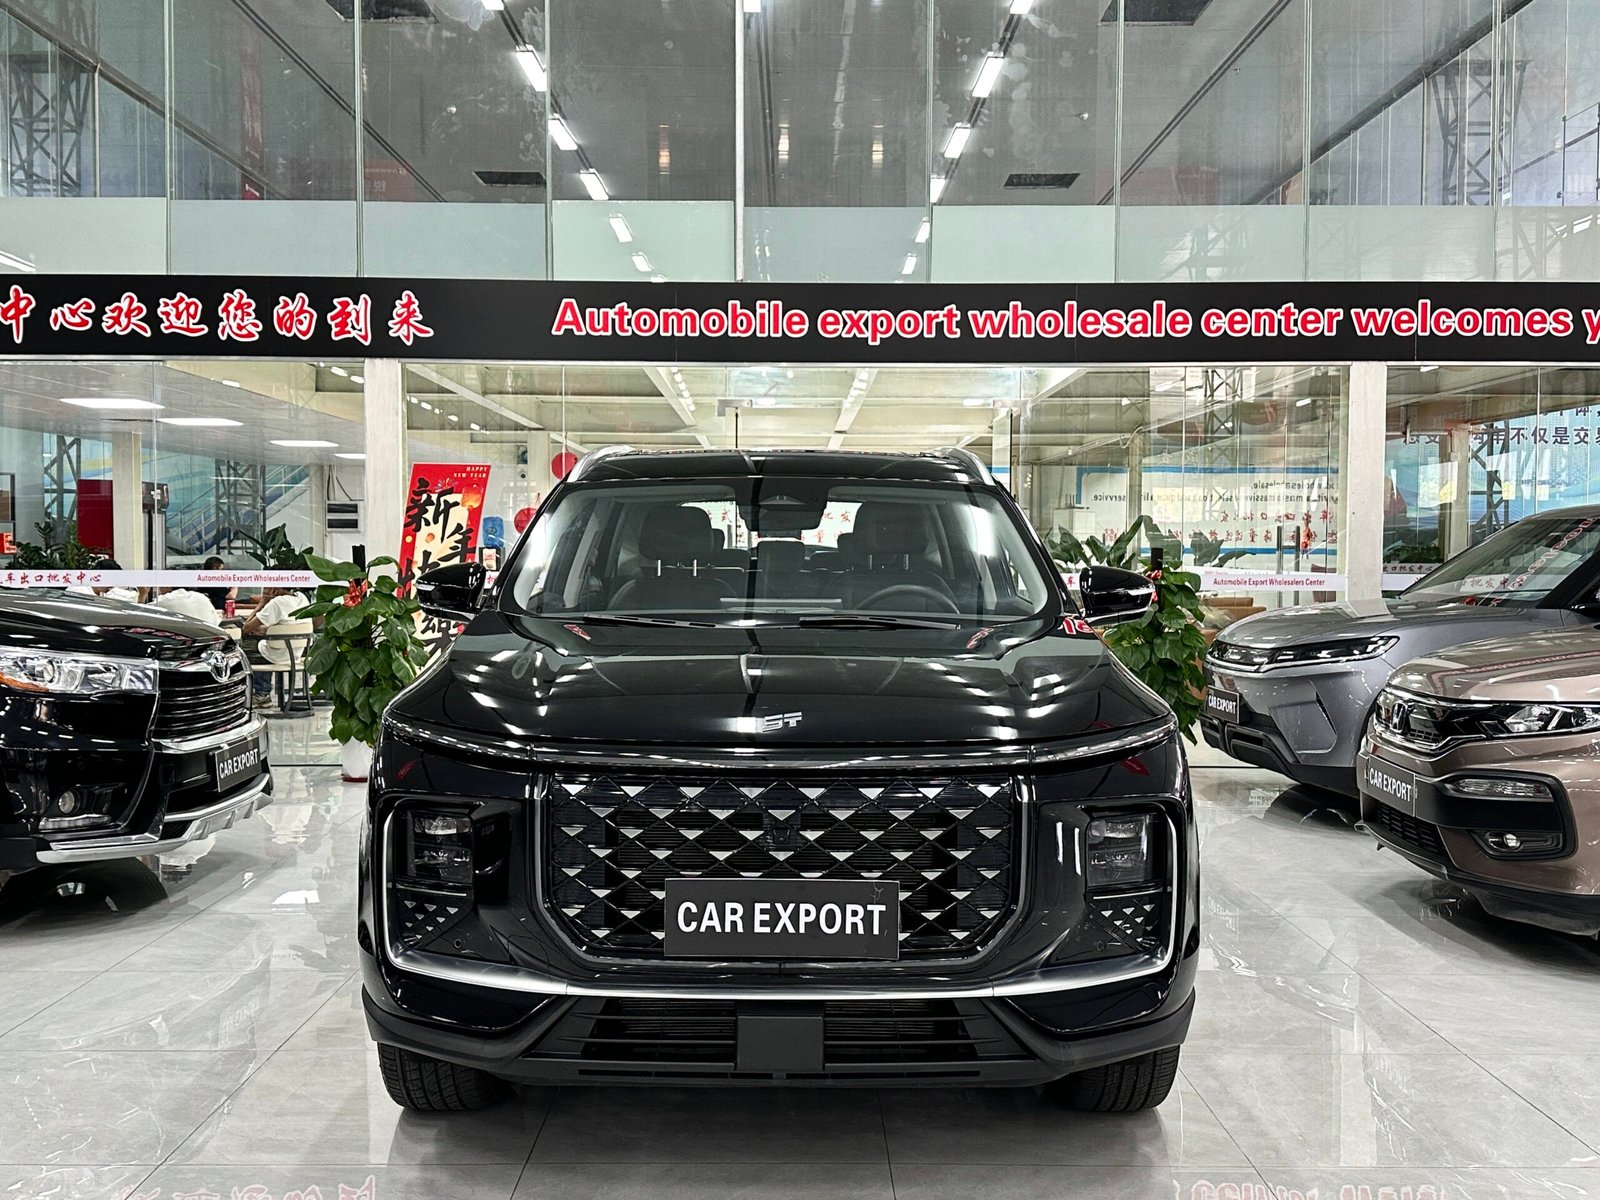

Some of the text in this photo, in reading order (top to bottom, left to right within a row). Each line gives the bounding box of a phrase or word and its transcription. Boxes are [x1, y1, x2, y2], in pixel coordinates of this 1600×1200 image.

[0, 285, 434, 346] 中心欢迎您的到来
[551, 298, 809, 338] Automobile
[817, 303, 961, 346] export
[967, 298, 1192, 339] wholesale
[1200, 302, 1343, 338] center
[1350, 300, 1574, 338] welcomes
[197, 574, 311, 584] Automobile Export Wholesalers Center
[1213, 577, 1326, 588] Automobile Export Wholesalers Center
[1216, 697, 1237, 714] EXPORT
[219, 748, 258, 779] CAR EXPORT
[1370, 767, 1411, 802] CAR EXPORT
[677, 901, 887, 935] CAR EXPORT
